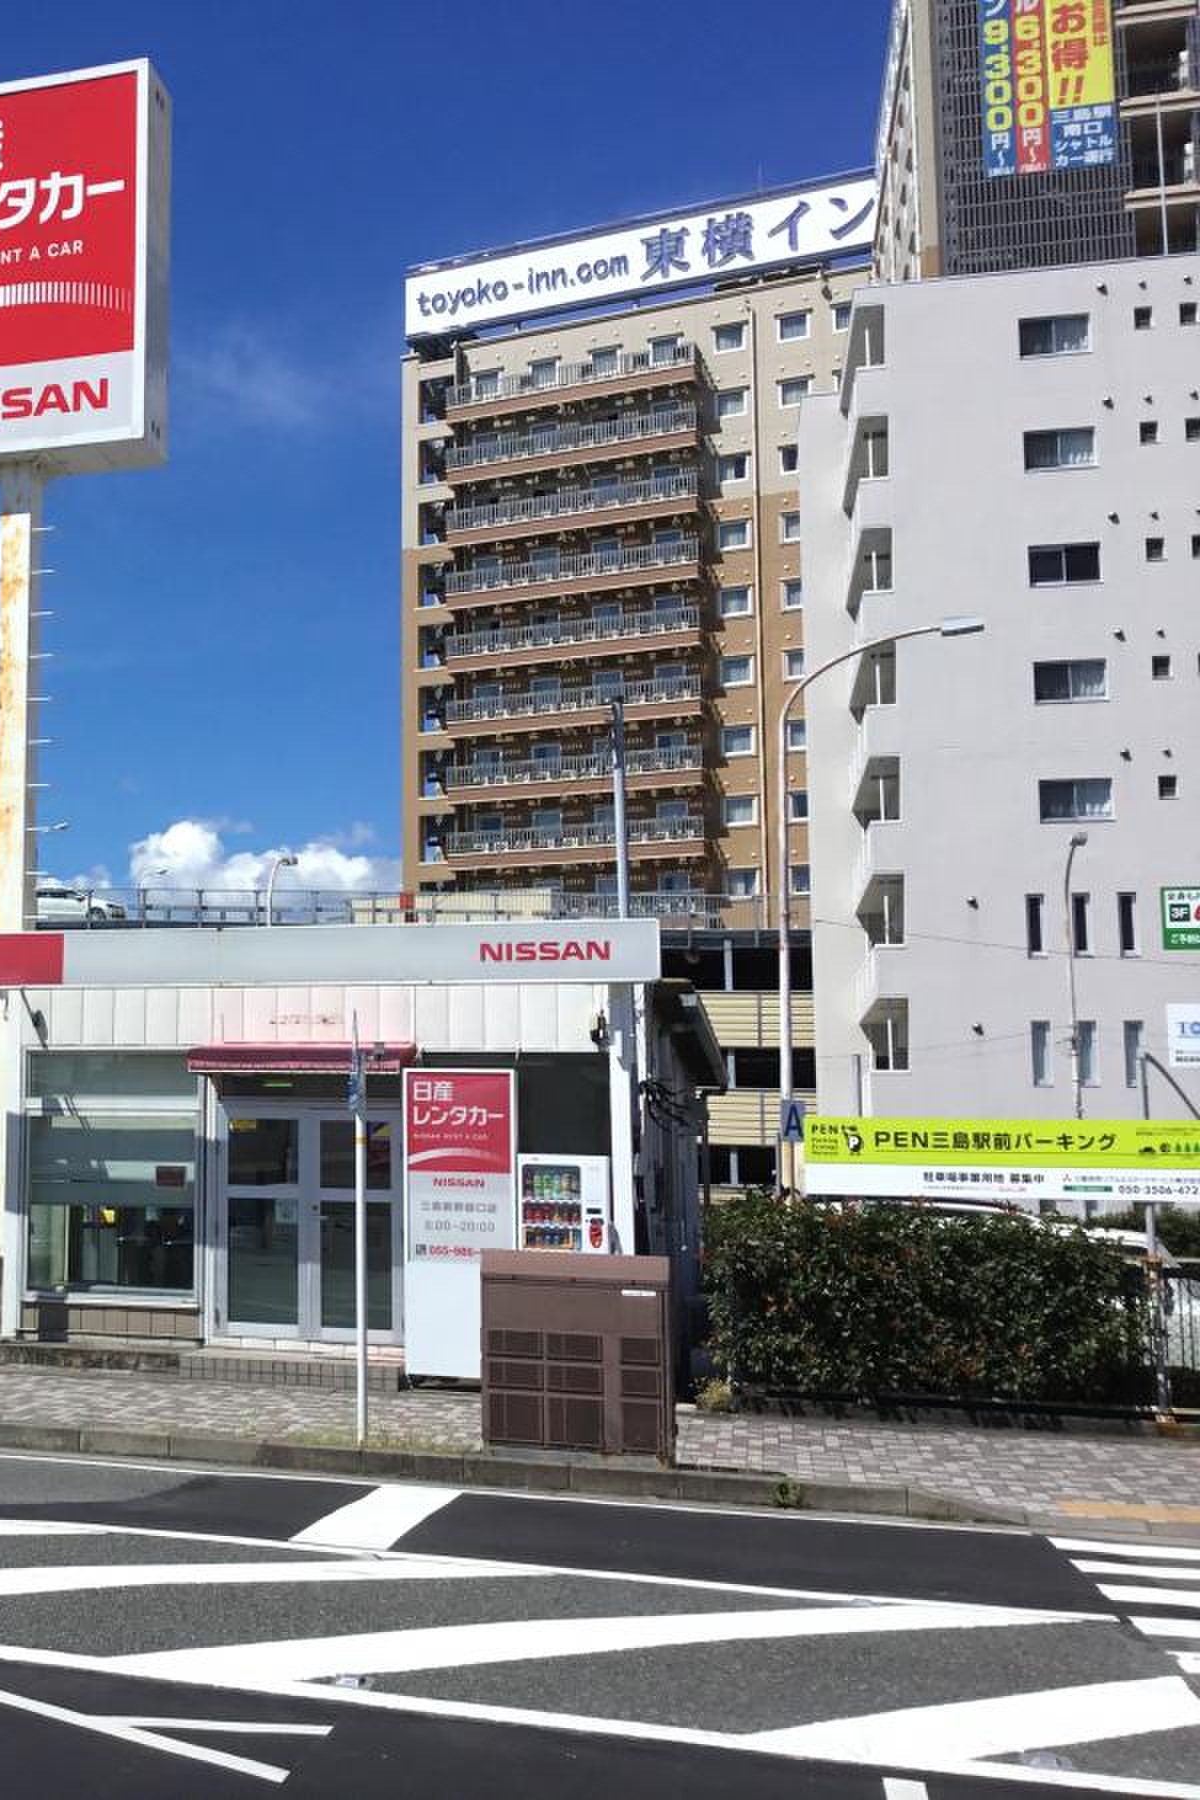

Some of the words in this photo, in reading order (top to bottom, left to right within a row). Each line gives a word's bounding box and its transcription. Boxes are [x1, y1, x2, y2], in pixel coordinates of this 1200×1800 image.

[30, 245, 40, 261] A
[47, 240, 84, 257] CAR
[417, 253, 629, 317] toyoko-inn.com
[640, 197, 875, 281] 東横イン
[479, 941, 612, 963] NISSAN
[412, 1081, 453, 1102] 日産
[412, 1105, 505, 1127] レンタカー
[783, 1103, 805, 1138] A
[811, 1124, 839, 1135] PEN
[874, 1131, 1117, 1154] PEN三島駅前パーキング
[432, 1178, 485, 1188] NISSAN
